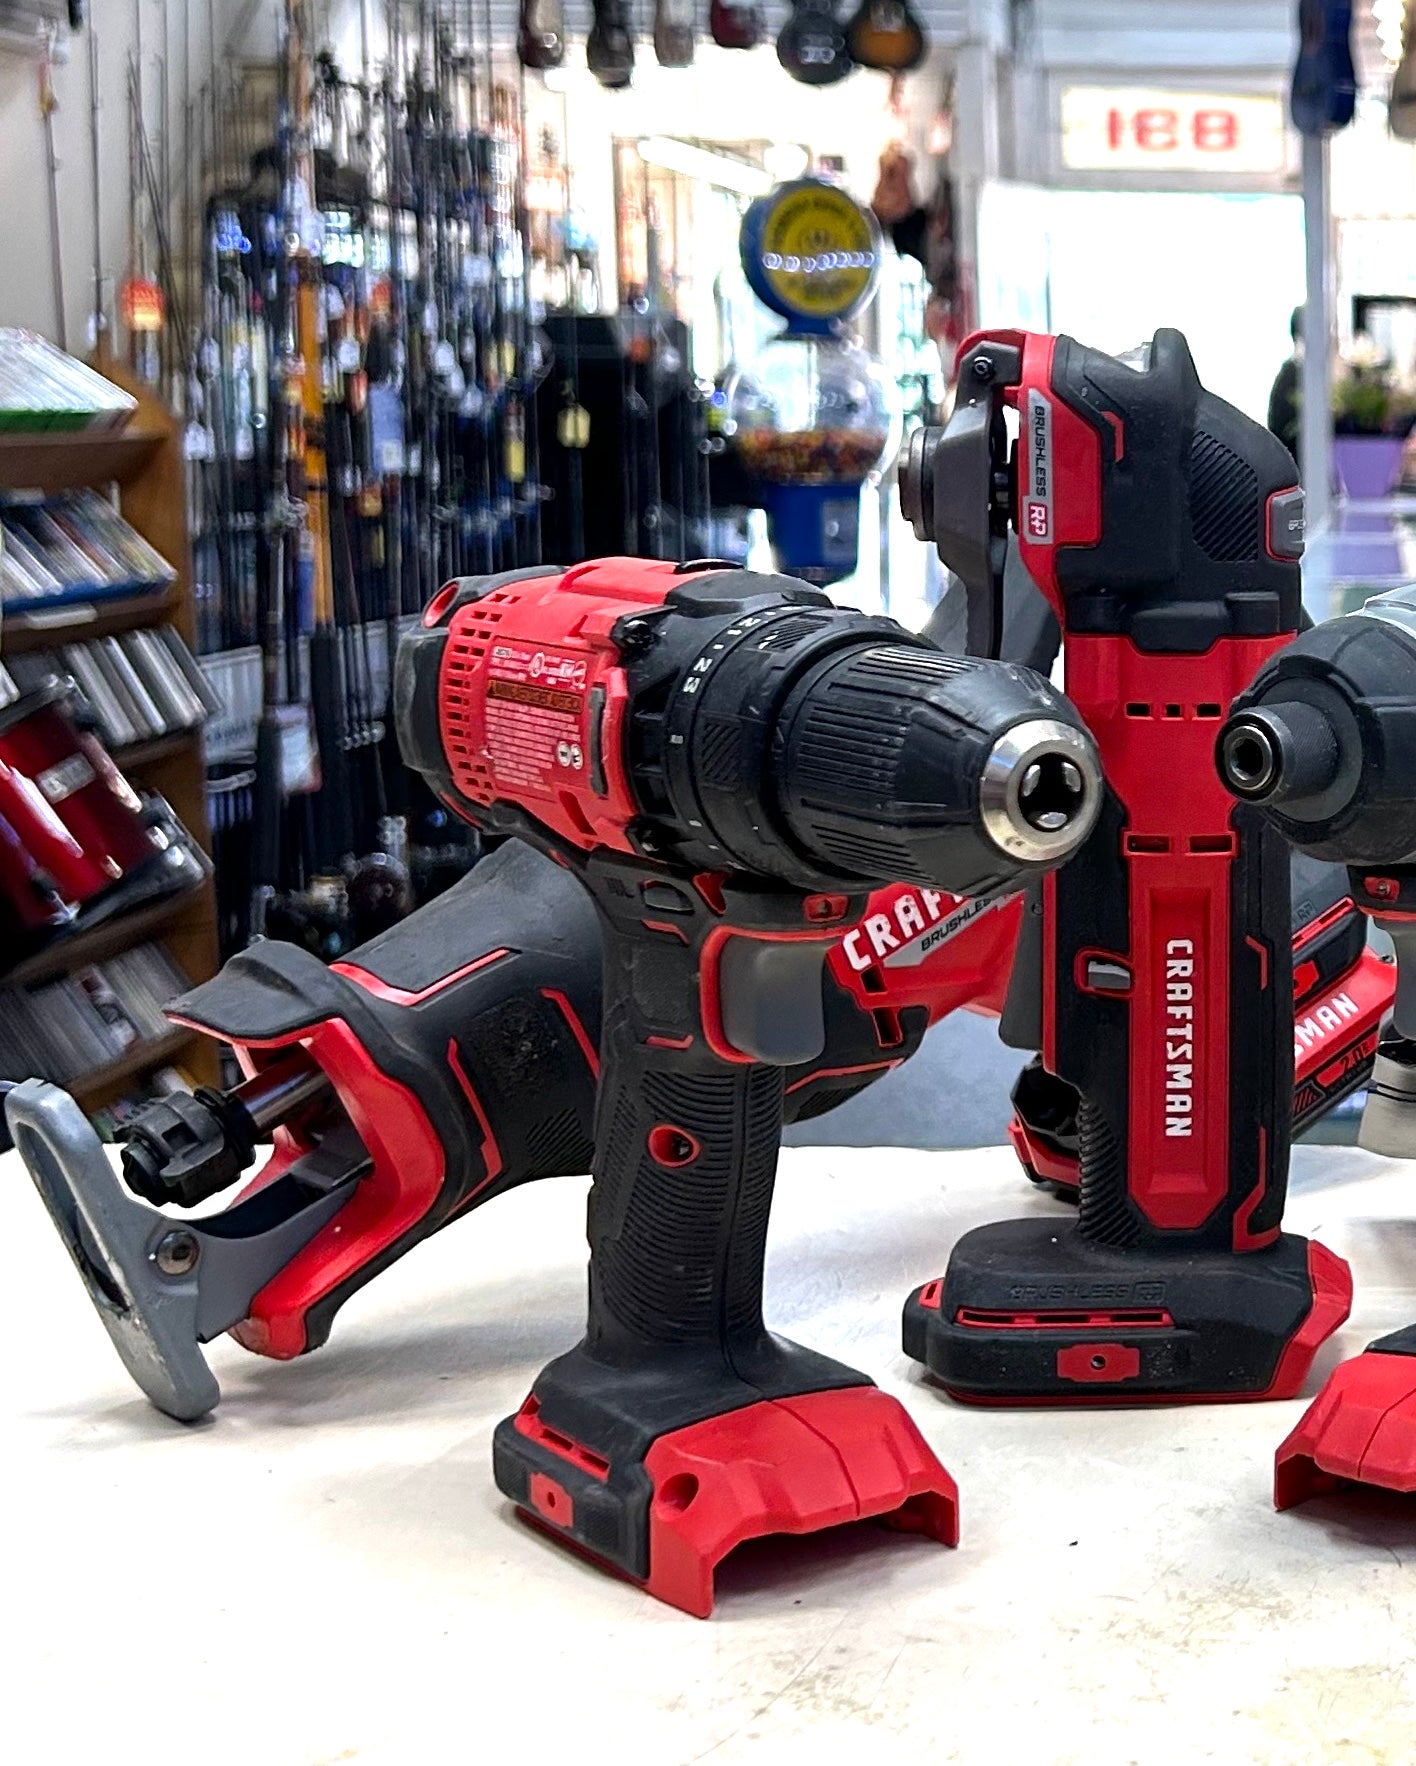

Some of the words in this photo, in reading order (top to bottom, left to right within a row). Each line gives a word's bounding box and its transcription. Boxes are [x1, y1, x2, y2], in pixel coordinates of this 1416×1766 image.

[1034, 405, 1047, 498] BRUSHLESS
[842, 888, 965, 971] CRAF
[1165, 939, 1194, 1137] CRAFTSMAN
[1294, 992, 1359, 1057] MAN
